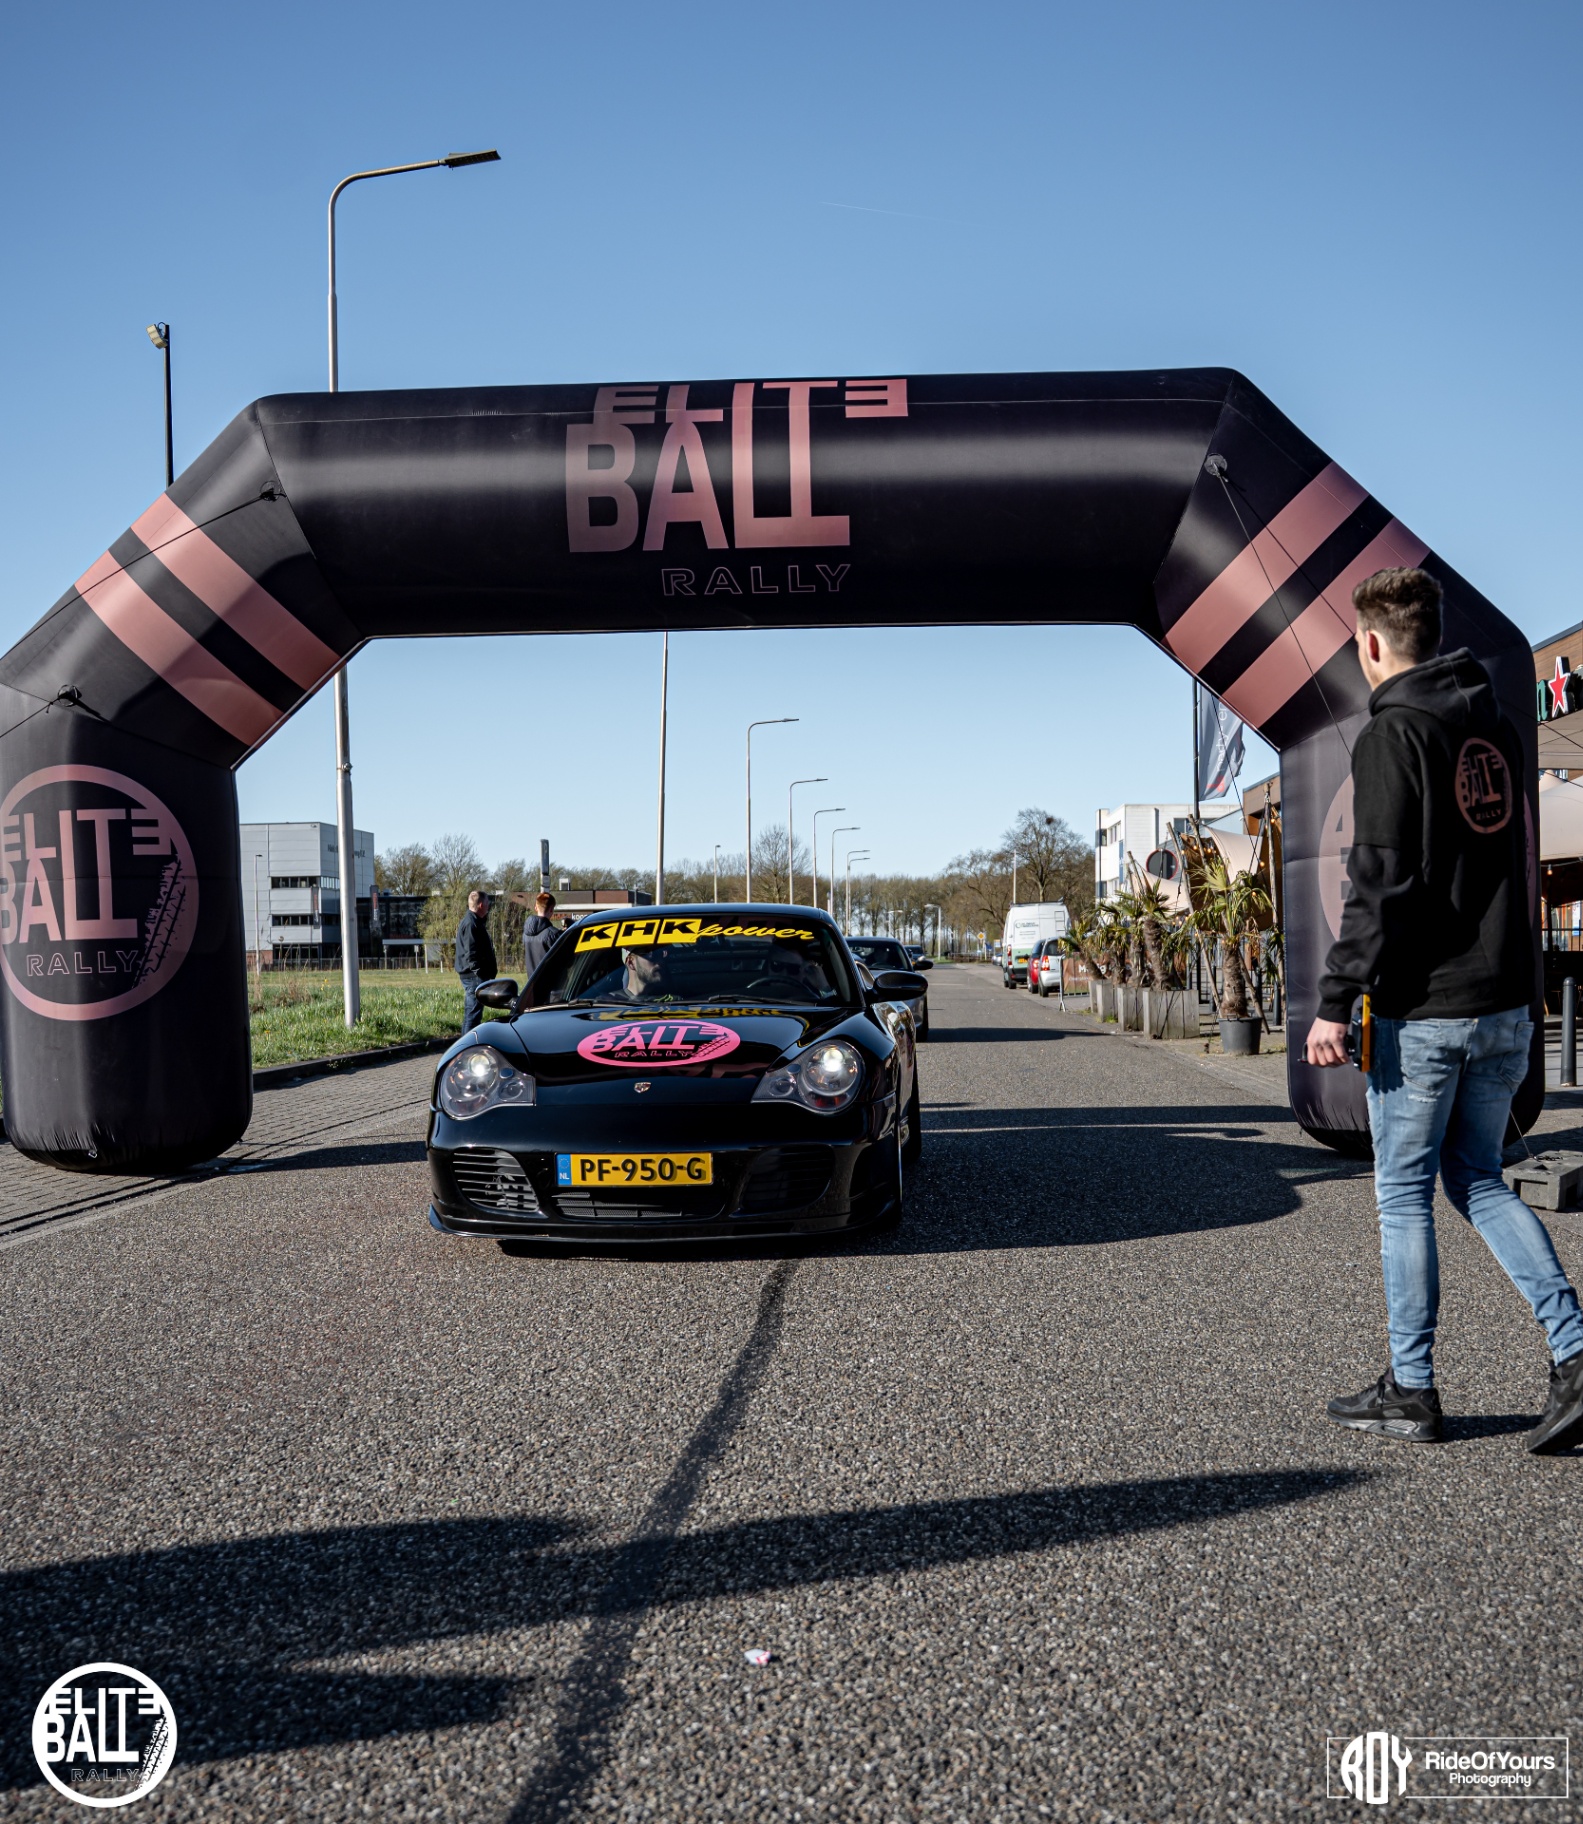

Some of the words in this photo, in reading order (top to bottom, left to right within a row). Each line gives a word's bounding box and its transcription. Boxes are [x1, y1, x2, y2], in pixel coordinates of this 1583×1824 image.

[661, 564, 850, 596] RALLY
[691, 922, 815, 941] power
[26, 950, 138, 977] RALLY
[614, 1050, 695, 1059] RALLY
[559, 1172, 570, 1180] NL
[579, 1157, 706, 1182] PF-950-G
